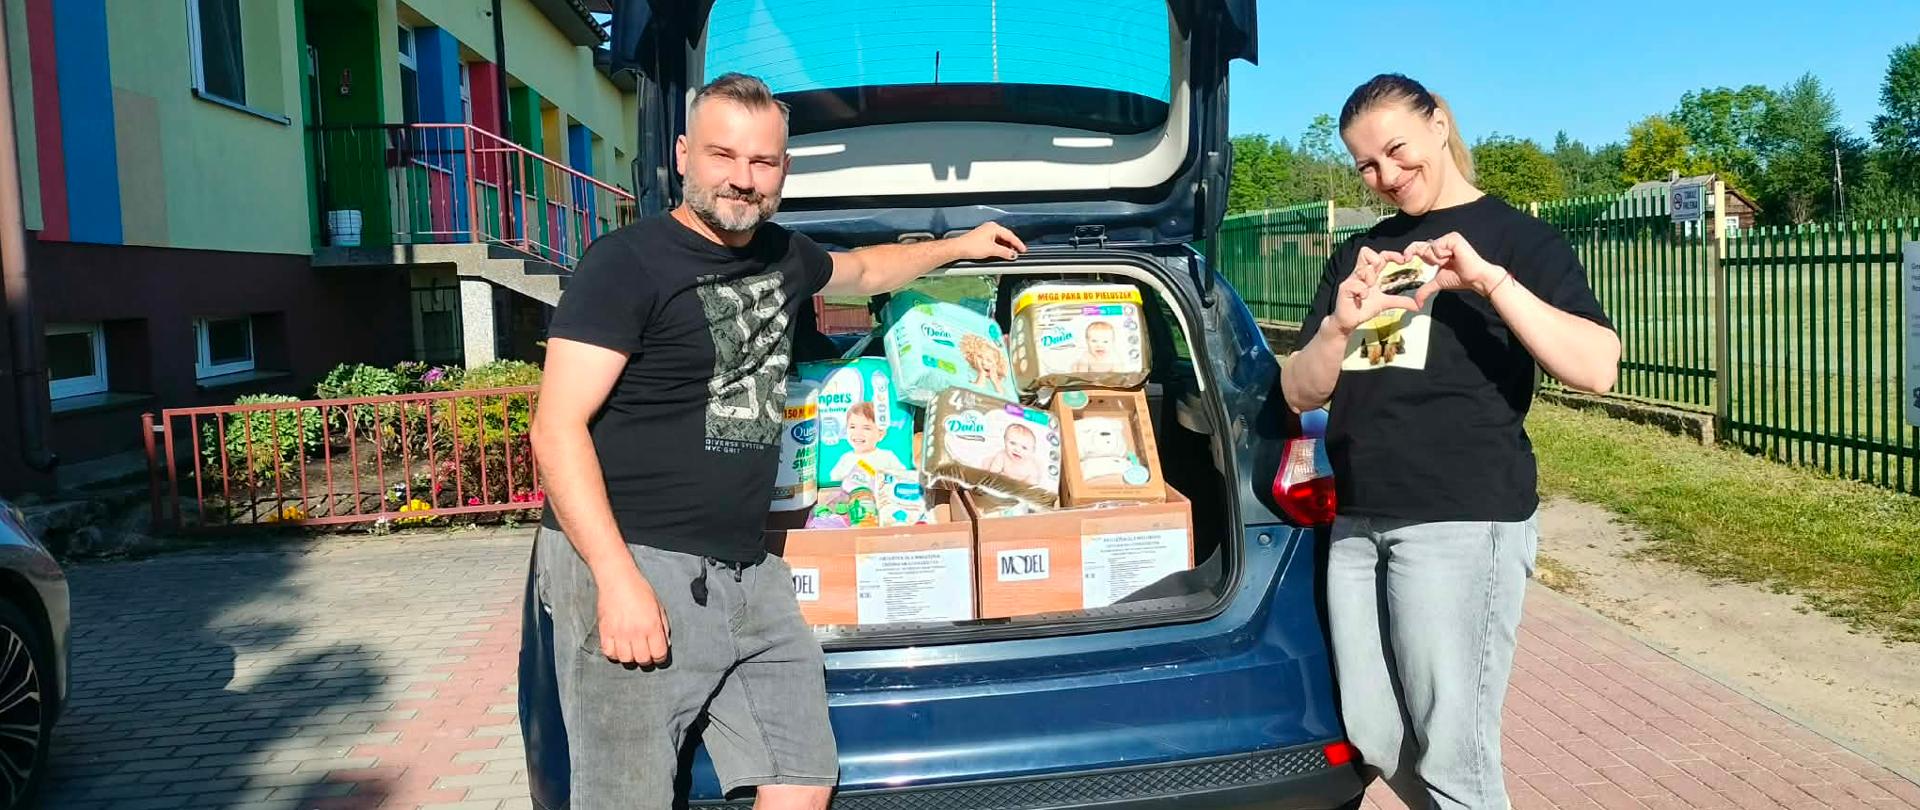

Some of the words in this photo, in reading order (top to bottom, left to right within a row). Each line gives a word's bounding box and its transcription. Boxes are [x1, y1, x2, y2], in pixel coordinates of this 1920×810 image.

[1038, 293, 1059, 301] MEGA
[1095, 291, 1132, 299] PIELUSZEK
[948, 389, 964, 411] 4
[705, 438, 739, 448] DIVERSE
[704, 445, 721, 453] NYC
[1001, 555, 1045, 575] MODEL
